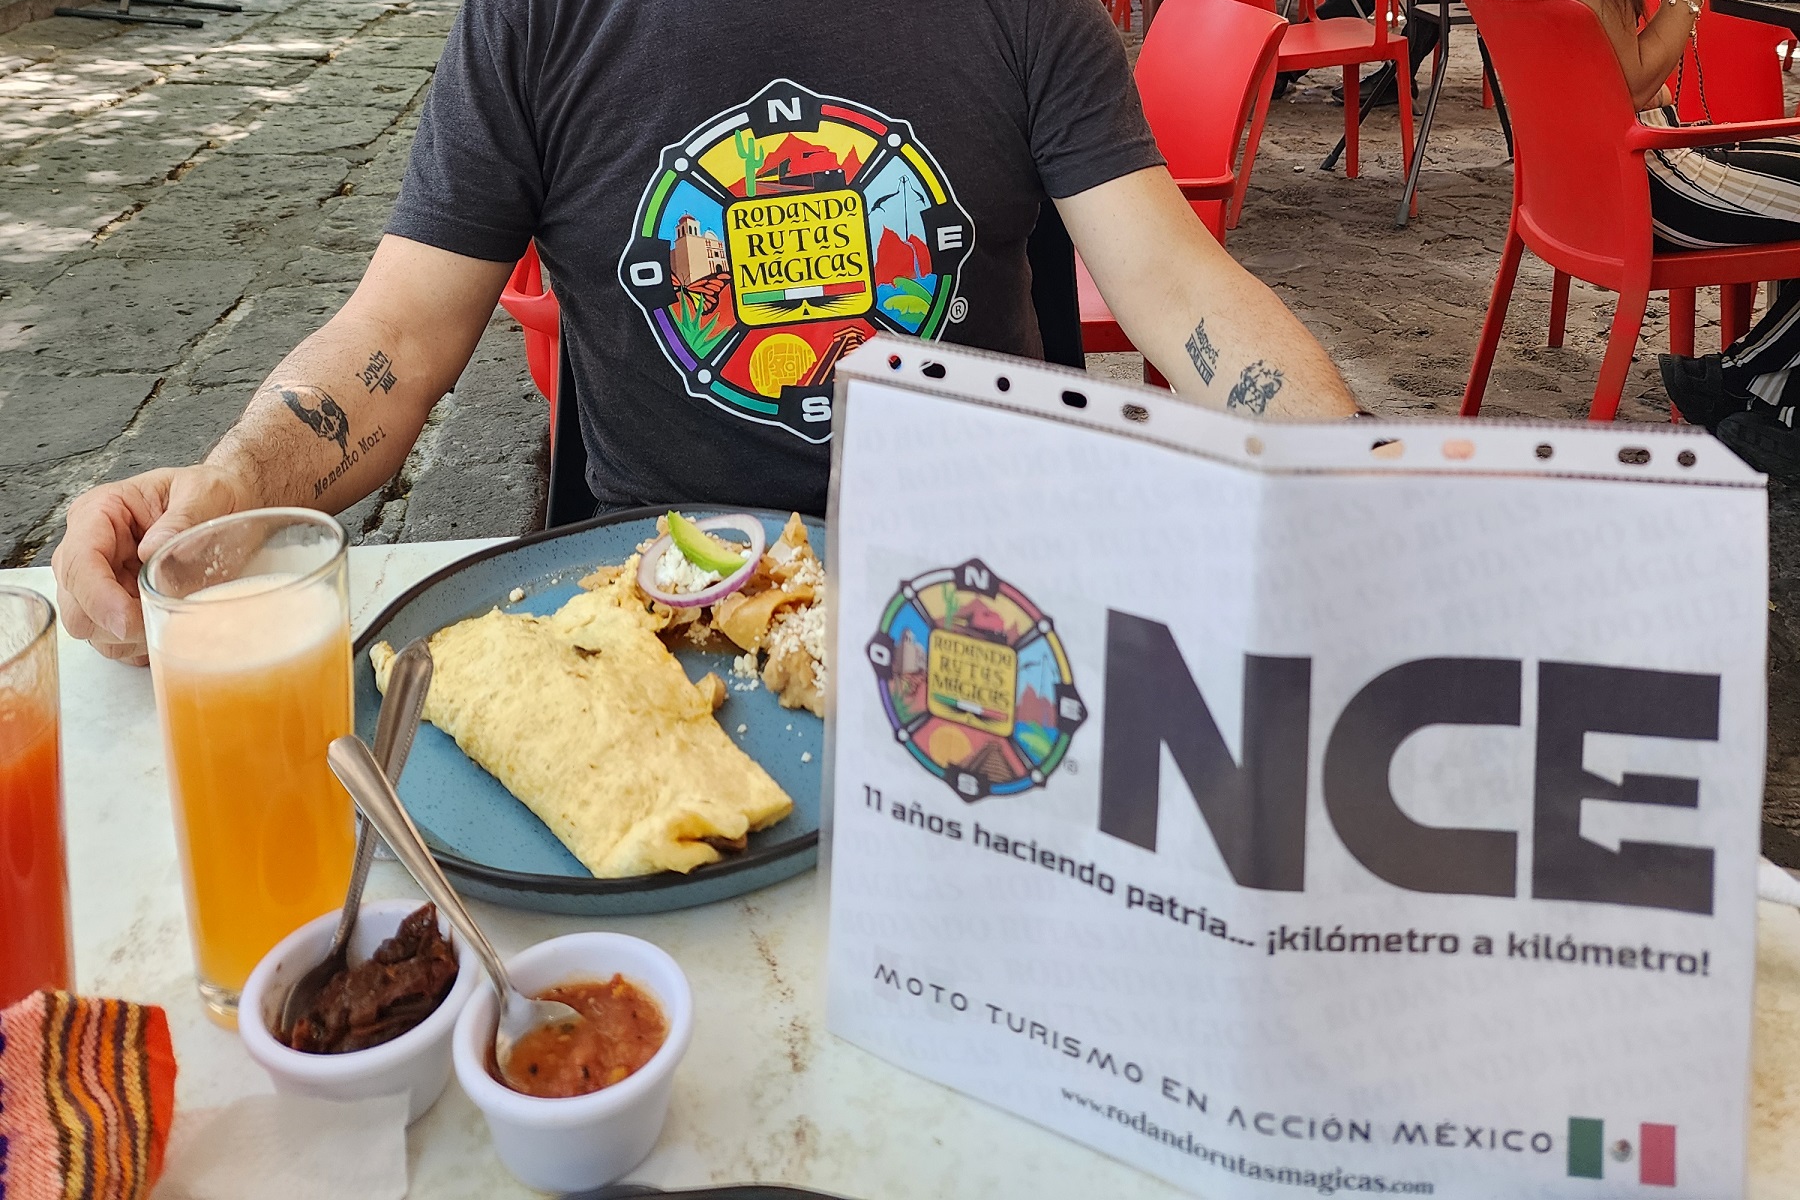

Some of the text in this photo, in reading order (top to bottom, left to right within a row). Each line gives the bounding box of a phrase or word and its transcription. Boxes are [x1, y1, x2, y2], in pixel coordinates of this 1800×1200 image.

[767, 98, 802, 123] N
[937, 225, 963, 250] E
[629, 261, 663, 287] O
[802, 396, 832, 422] S
[314, 425, 387, 499] Memento Mori
[964, 566, 990, 590] N
[863, 784, 882, 813] 11
[891, 803, 963, 841] años
[974, 822, 1116, 896] haciendo
[1266, 923, 1460, 957] ¡kilómetro
[1472, 934, 1494, 956] a
[1506, 931, 1711, 977] kilómetro!
[874, 963, 1554, 1155] MOTO TURISMO EN ACCIÓN MÉXICO
[1061, 1087, 1435, 1197] www.rodandorutasmagicas.com
